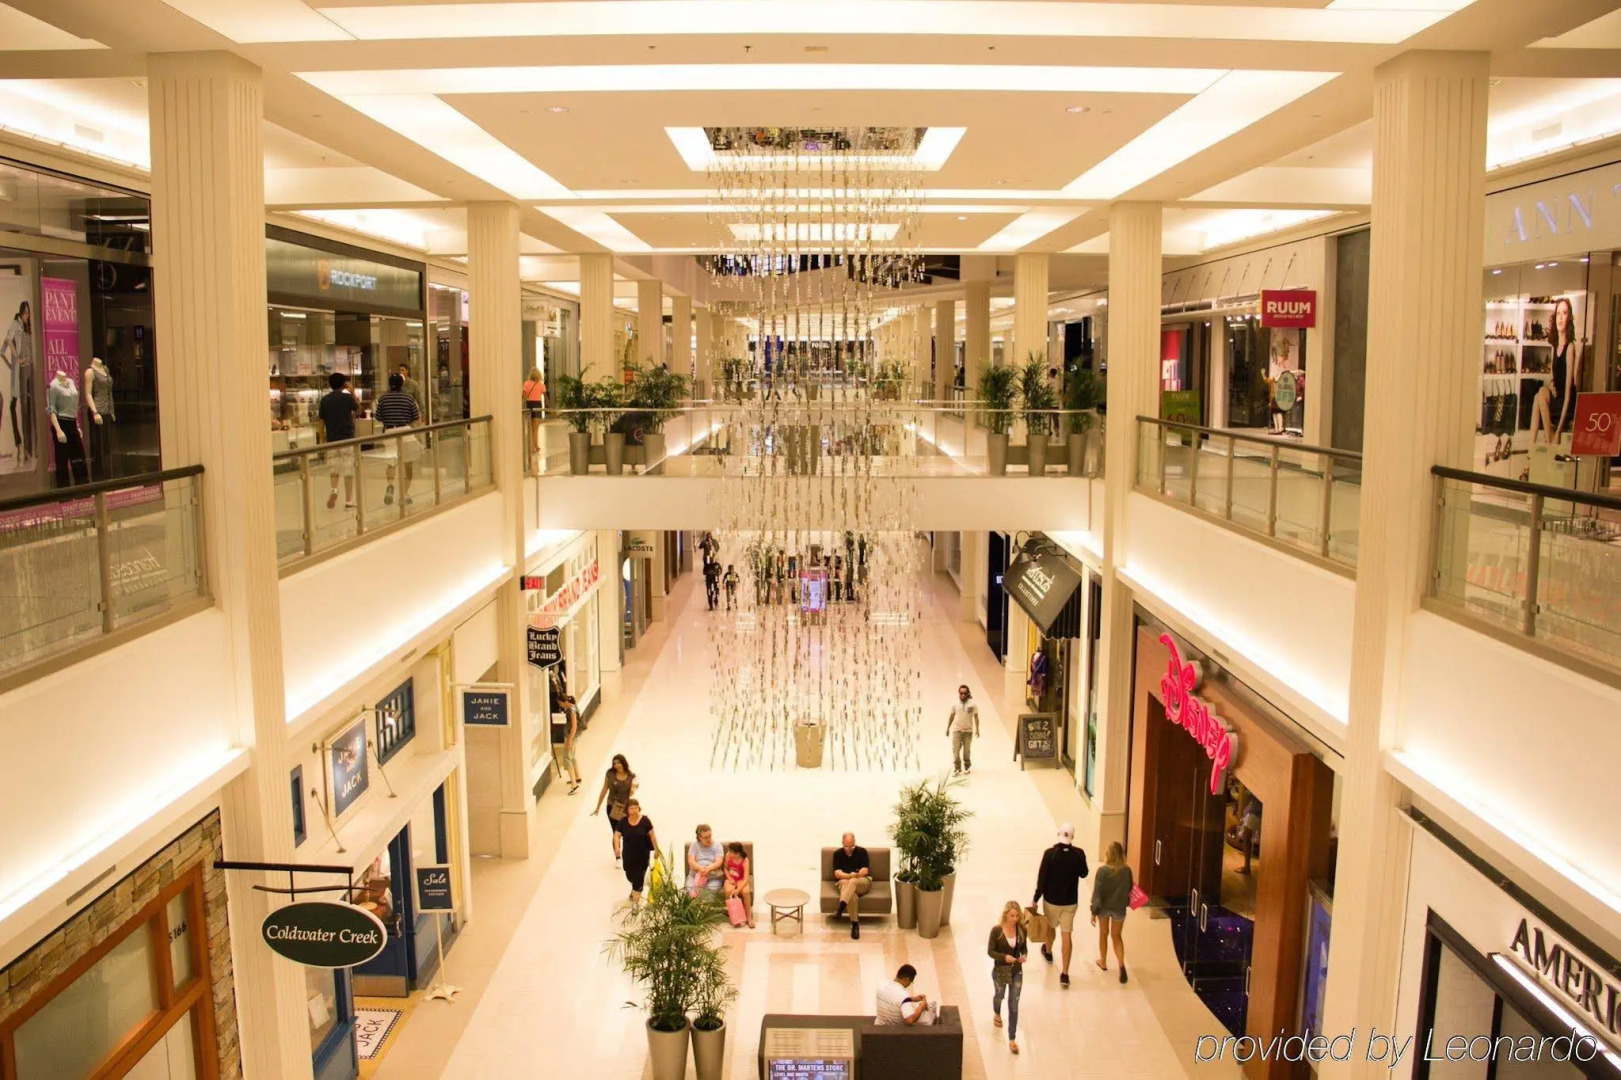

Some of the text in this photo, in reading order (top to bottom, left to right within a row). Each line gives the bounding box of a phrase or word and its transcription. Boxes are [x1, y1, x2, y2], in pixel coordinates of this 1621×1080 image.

[1505, 190, 1596, 246] ANN
[330, 268, 377, 291] ROCKPORT
[45, 291, 76, 310] PANT
[1267, 301, 1311, 314] RUUM
[46, 308, 77, 323] EVENT
[47, 339, 68, 355] ALL
[47, 355, 79, 371] PANTS
[528, 631, 558, 641] Lucky
[528, 641, 558, 650] Brand
[528, 650, 557, 660] Jeans
[341, 771, 362, 798] JACK
[423, 873, 447, 885] Sale
[266, 925, 378, 944] Coldwater Creek
[357, 1019, 384, 1047] JACK
